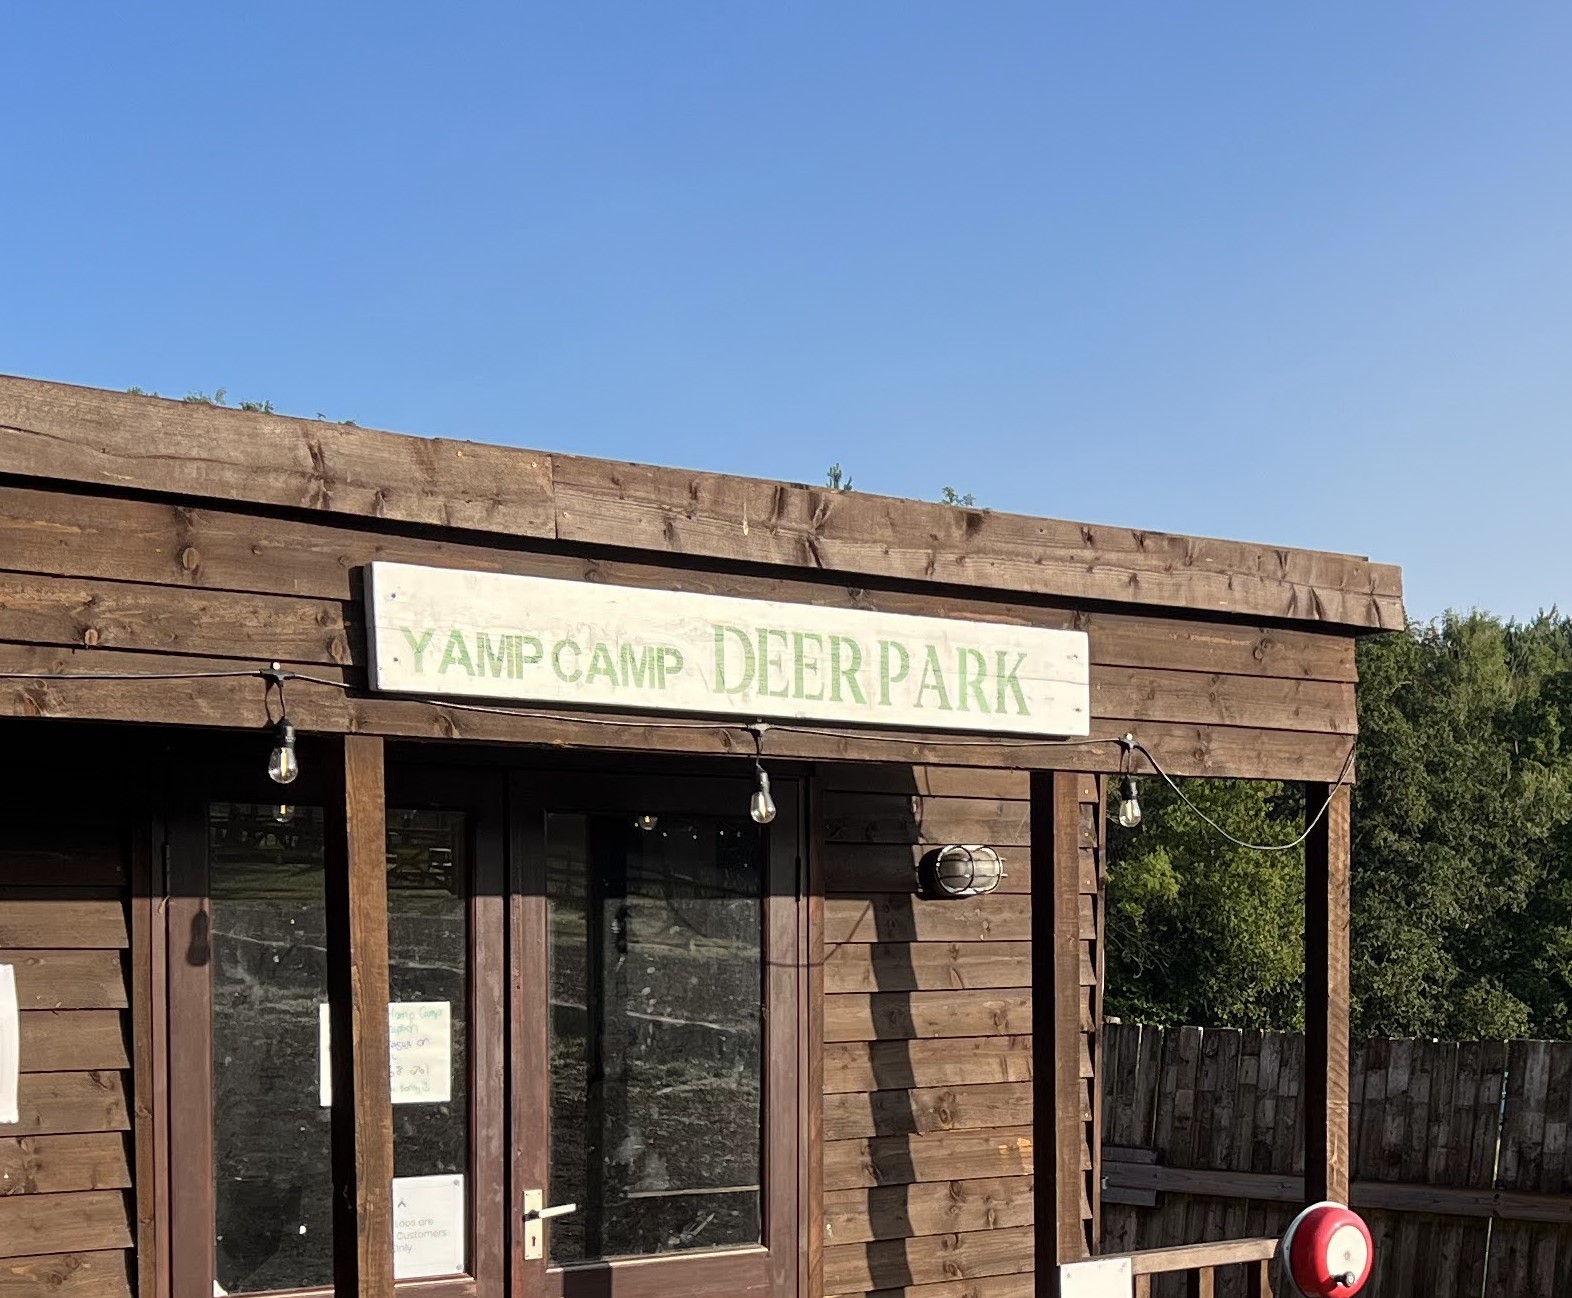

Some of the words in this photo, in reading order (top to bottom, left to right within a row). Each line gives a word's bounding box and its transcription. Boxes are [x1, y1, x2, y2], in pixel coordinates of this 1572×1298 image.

[400, 625, 544, 680] YAMP
[551, 638, 684, 690] CAMP
[710, 624, 868, 705] DEER
[875, 639, 1032, 717] PARK
[396, 1229, 447, 1240] Customers
